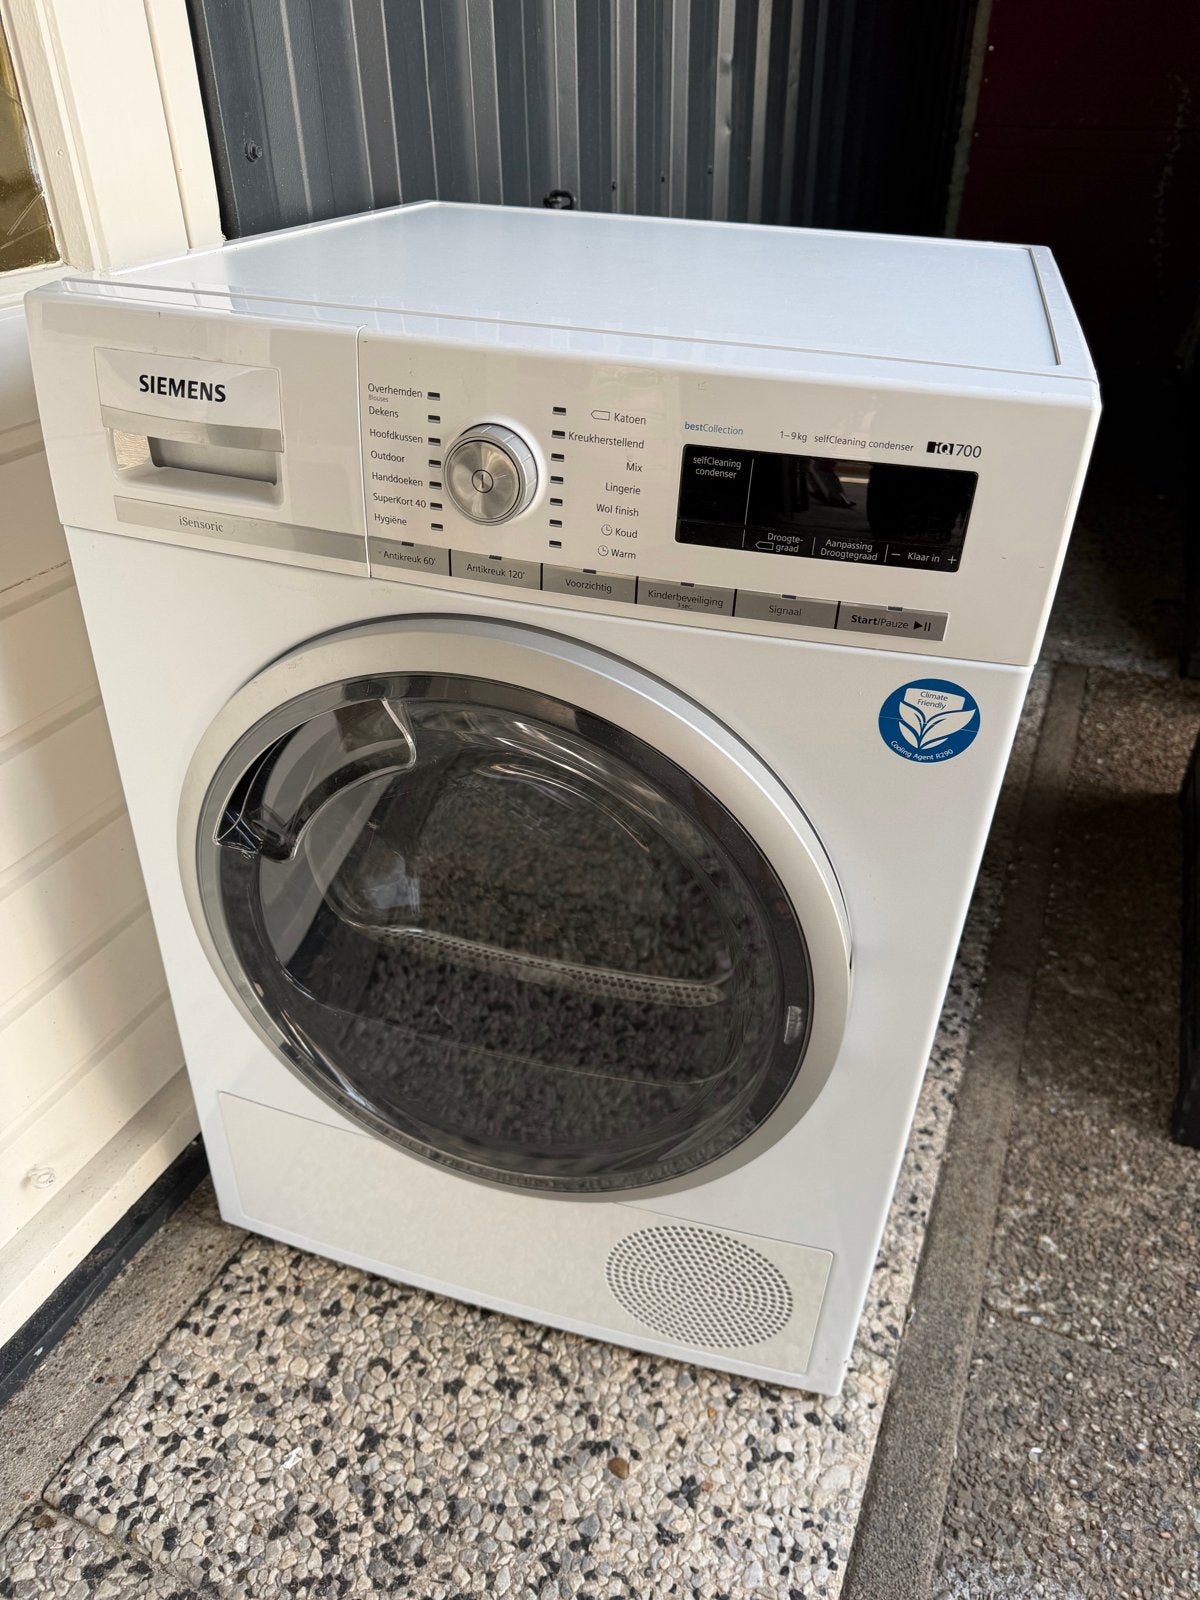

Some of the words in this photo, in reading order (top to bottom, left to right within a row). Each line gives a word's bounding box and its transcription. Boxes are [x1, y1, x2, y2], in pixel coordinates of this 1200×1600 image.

[139, 374, 226, 402] SIEMENS
[368, 383, 422, 398] Overhemden
[369, 406, 399, 418] Dekens
[614, 412, 646, 425] Katoen
[684, 421, 744, 435] bestCollection
[370, 429, 423, 443] Hoofdkussen
[568, 432, 645, 449] Kreukherstellend
[814, 435, 866, 448] selfCleaning
[869, 440, 914, 451] condenser
[371, 451, 404, 462] Outdoor
[693, 456, 742, 470] selfCleaning
[626, 462, 642, 472] Mix
[696, 468, 736, 478] condenser
[372, 472, 423, 486] Handdoeken
[606, 482, 641, 495] Lingerie
[373, 493, 413, 506] SuperKort
[415, 500, 426, 508] 40
[596, 503, 613, 513] Wol
[615, 506, 639, 516] finish
[178, 515, 223, 532] iSensoric
[374, 513, 407, 525] Hygiëne
[615, 528, 638, 538] Koud
[768, 532, 804, 544] Droogte-
[776, 544, 799, 552] graad
[826, 539, 873, 553] Aanpassing
[384, 551, 422, 564] Antikreuk
[611, 549, 636, 559] Warm
[820, 548, 878, 561] Droogtegraad
[907, 552, 929, 562] Klaar
[931, 554, 939, 562] in
[467, 563, 506, 577] Antikreuk
[565, 578, 612, 594] Voorzichtig
[648, 590, 723, 608] Kinderbeveiliging
[769, 605, 801, 616] Signaal
[851, 614, 909, 629] Start/Pauze
[920, 691, 948, 701] Climate
[917, 699, 946, 710] Friendly
[890, 740, 911, 757] Cooling
[936, 749, 953, 759] R290
